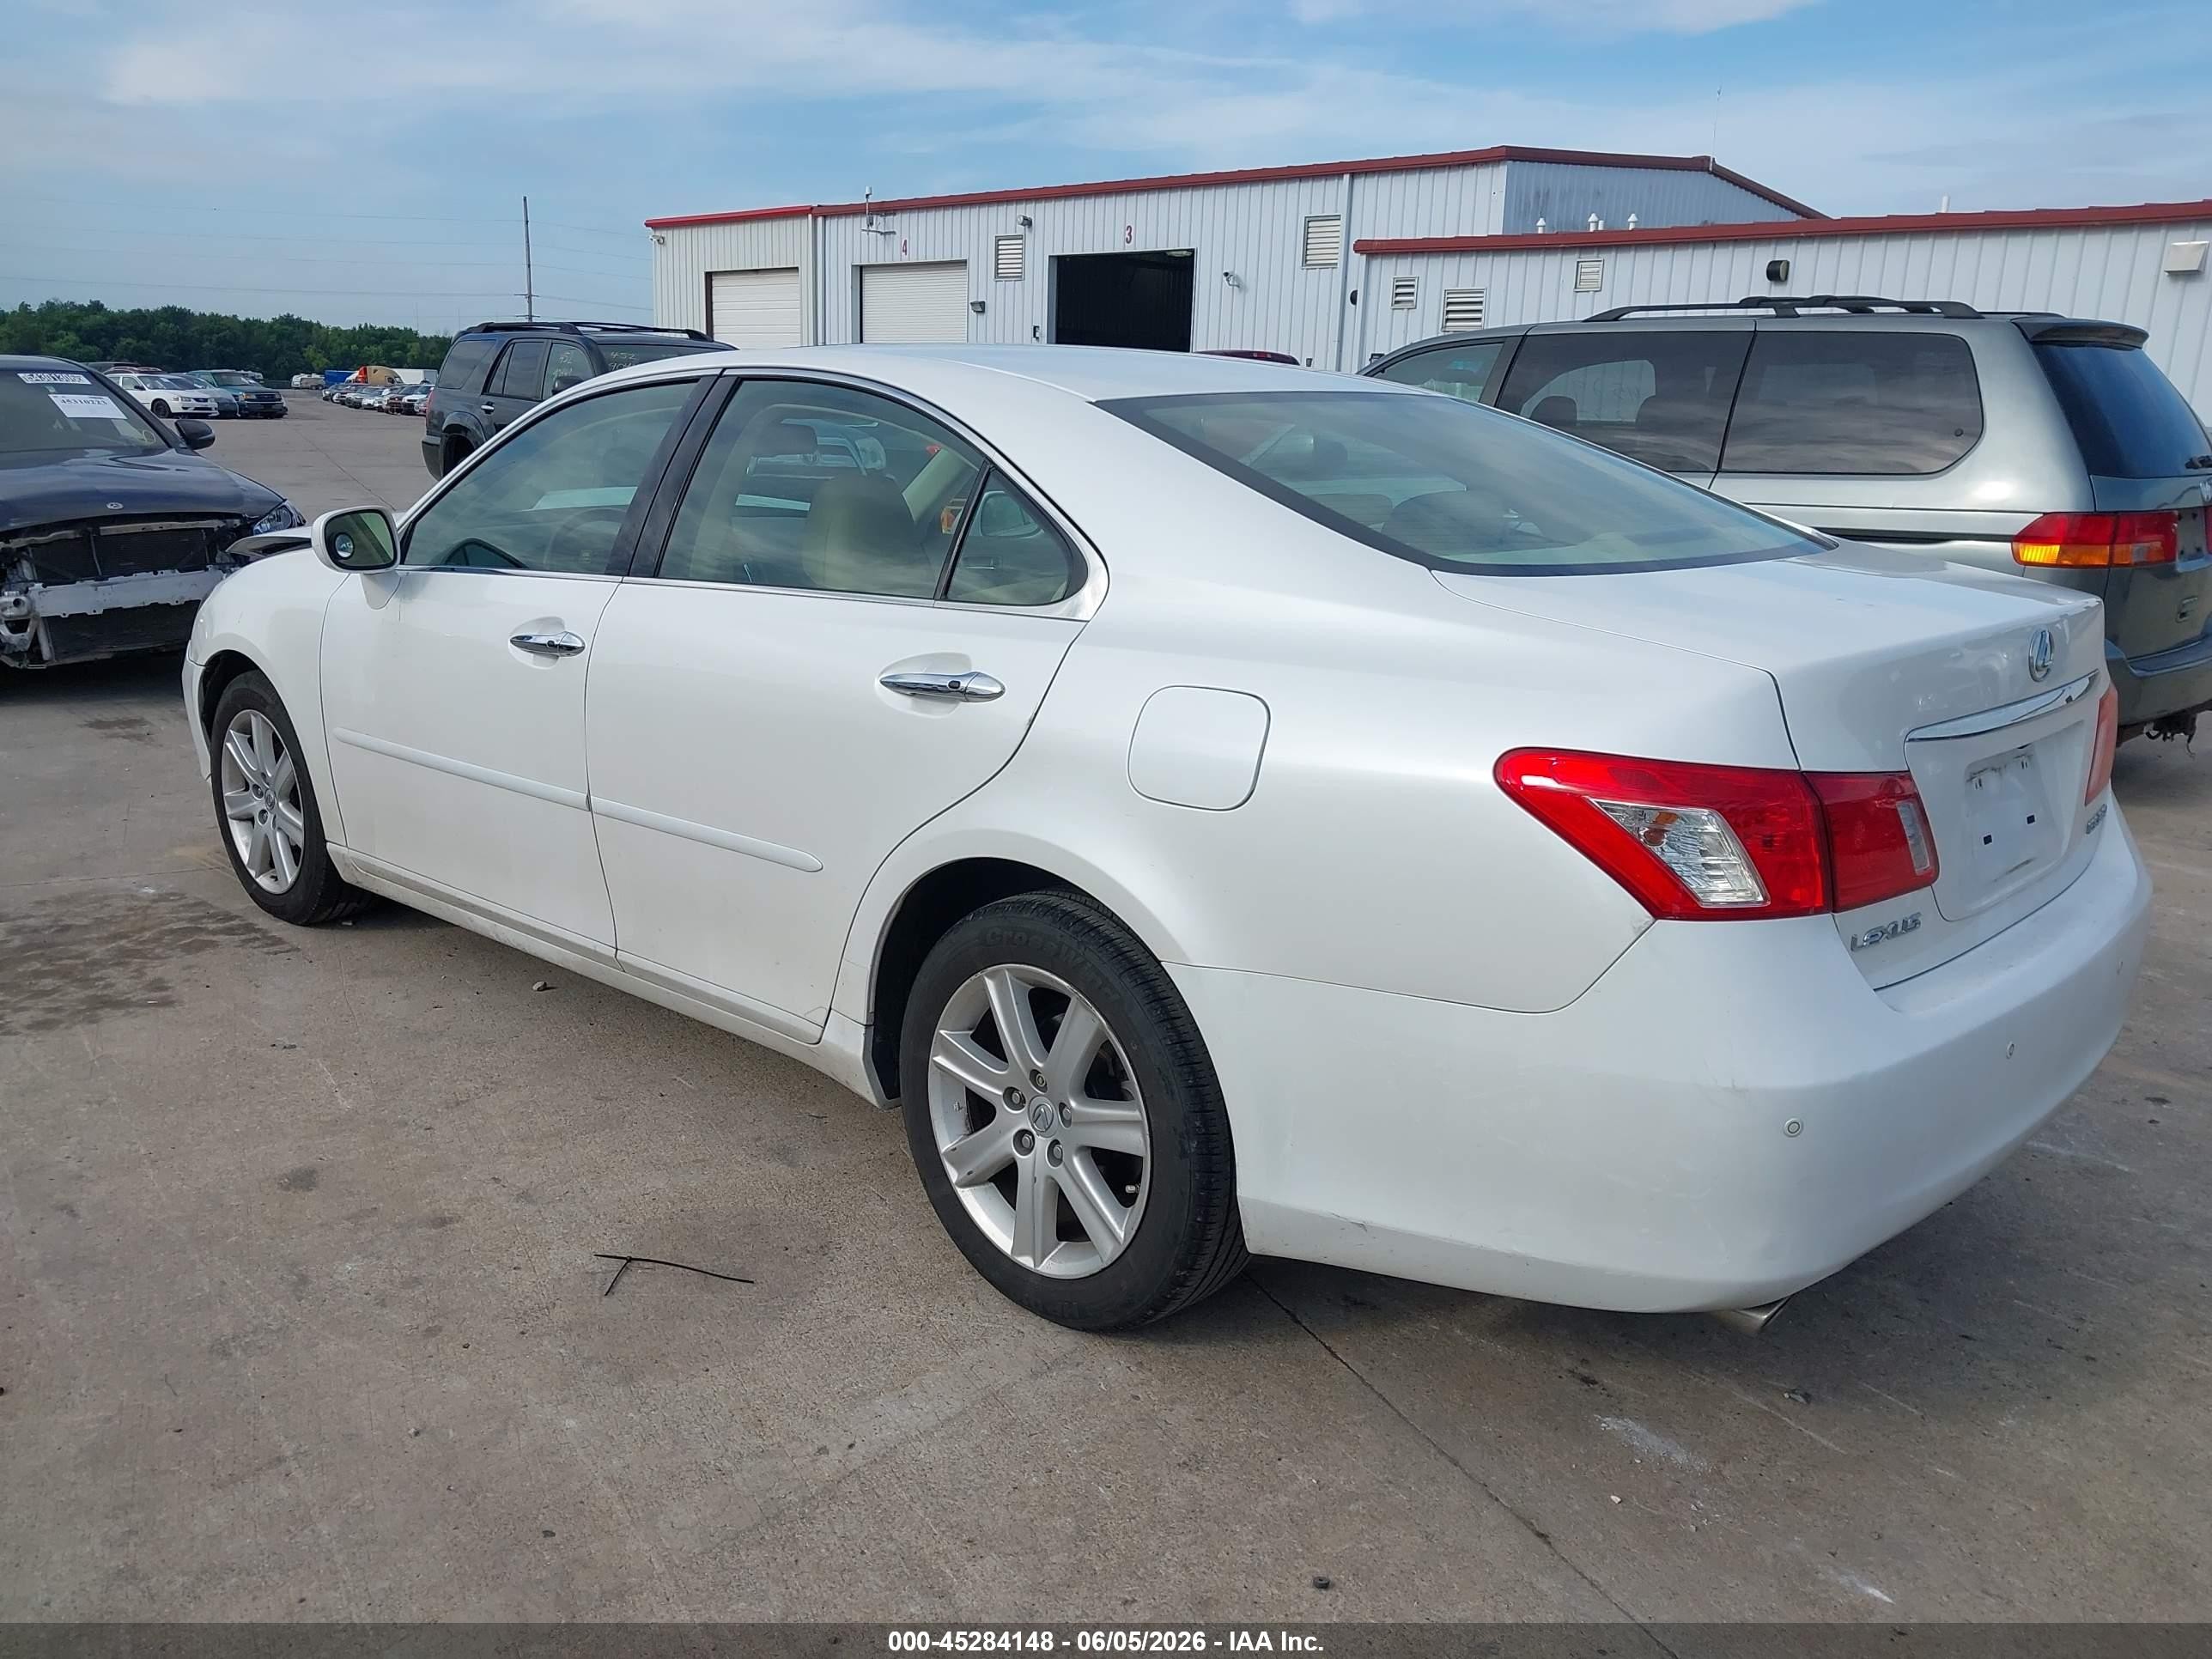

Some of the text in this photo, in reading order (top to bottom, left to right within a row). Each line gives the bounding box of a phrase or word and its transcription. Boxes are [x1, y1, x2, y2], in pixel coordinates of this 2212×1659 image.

[1125, 225, 1133, 244] 3
[901, 239, 908, 256] 4
[1850, 912, 1922, 951] LEXUS
